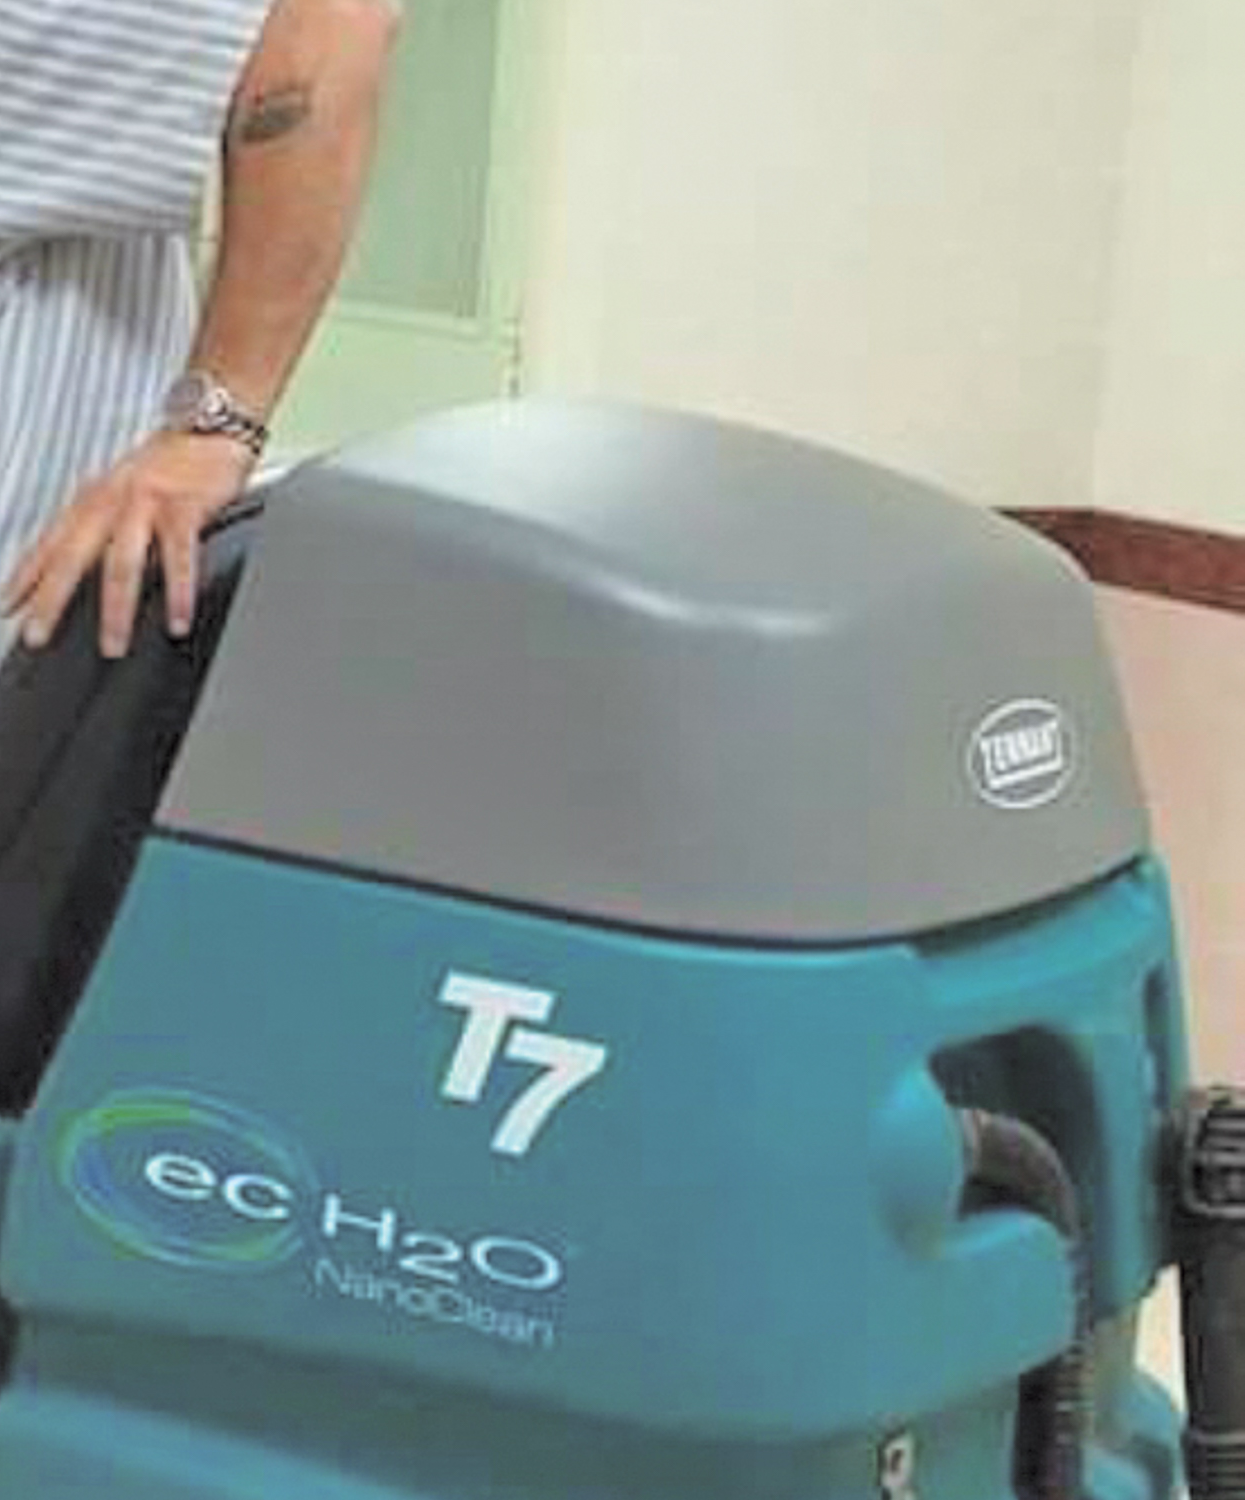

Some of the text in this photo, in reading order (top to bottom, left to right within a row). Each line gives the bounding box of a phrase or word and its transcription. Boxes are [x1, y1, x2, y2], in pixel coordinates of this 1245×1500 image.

[438, 971, 608, 1155] T7
[145, 1153, 562, 1289] ec H2O
[314, 1257, 556, 1349] NanoClean
